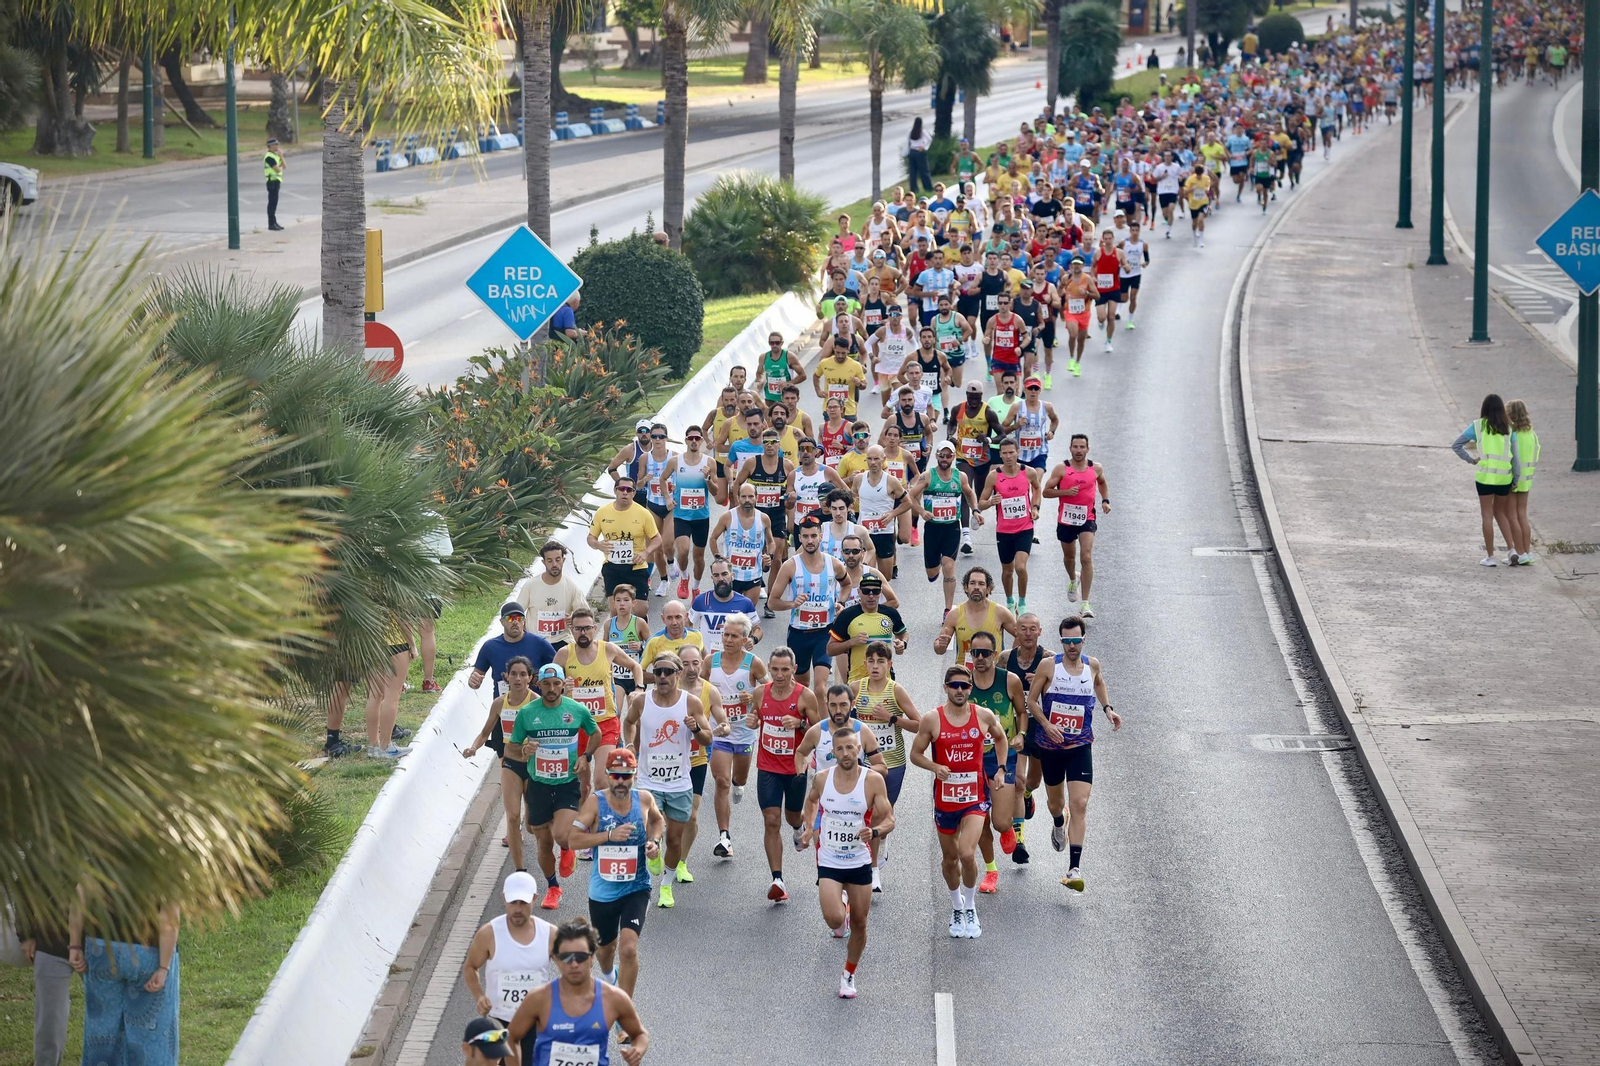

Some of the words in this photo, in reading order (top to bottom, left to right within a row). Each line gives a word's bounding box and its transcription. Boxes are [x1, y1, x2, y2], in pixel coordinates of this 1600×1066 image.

[504, 266, 542, 281] RED
[1023, 439, 1037, 447] 171
[966, 447, 977, 455] 45
[687, 498, 699, 506] 55
[761, 495, 777, 503] 182
[937, 509, 953, 517] 110
[1003, 504, 1026, 514] 11948
[1063, 511, 1086, 520] 11949
[610, 549, 632, 559] 7122
[735, 558, 752, 567] 174
[807, 614, 820, 623] 23
[542, 622, 560, 632] 311
[582, 677, 604, 687] Álora
[1055, 716, 1078, 728] 230
[536, 729, 570, 737] ATLETISMO
[767, 738, 788, 749] 189
[944, 748, 974, 762] Vélez
[541, 762, 563, 773] 138
[651, 766, 680, 777] 2077
[949, 786, 972, 797] 154
[827, 830, 861, 842] 11884
[610, 862, 627, 874] 85
